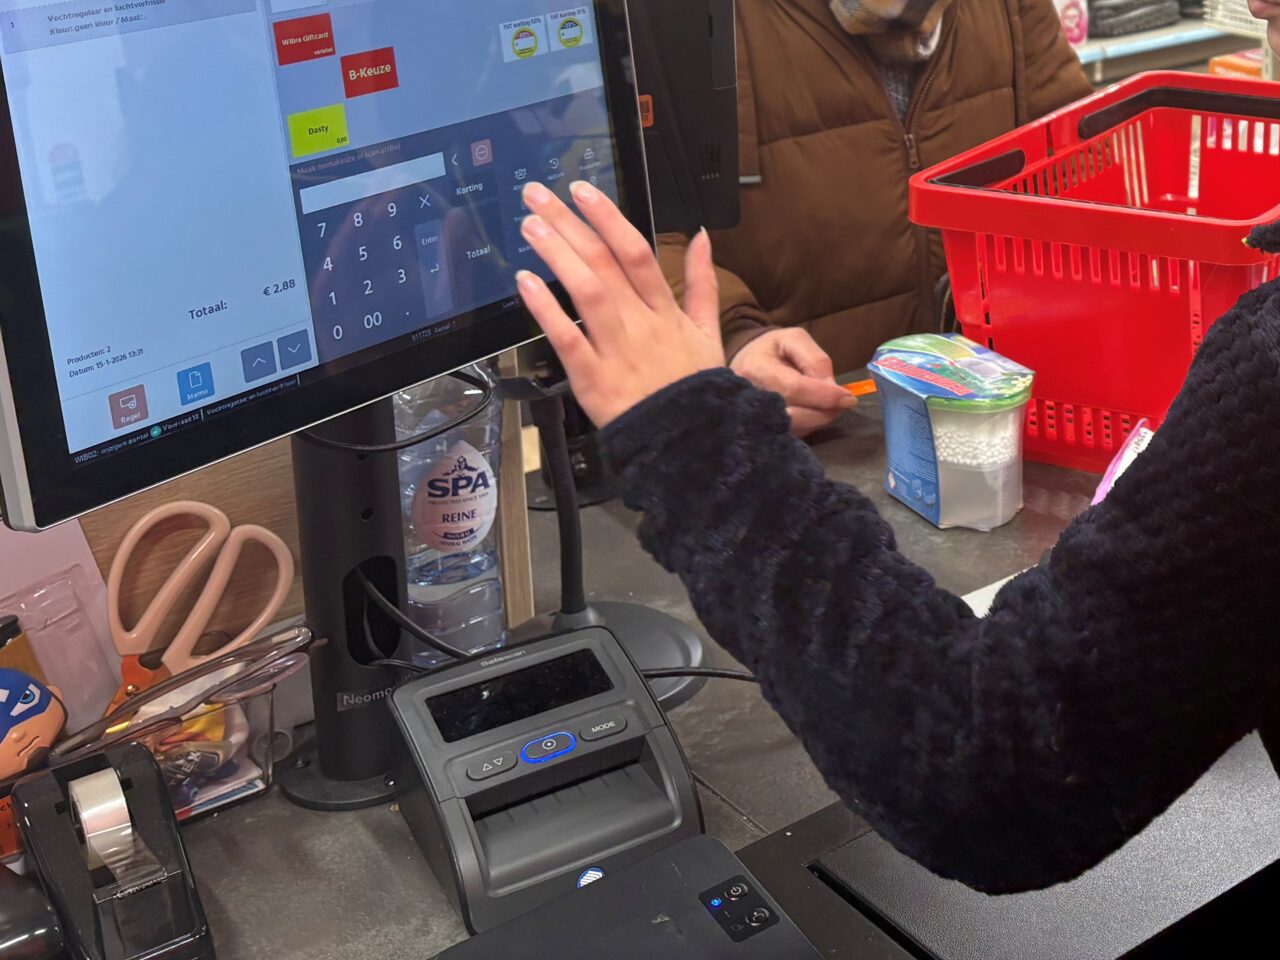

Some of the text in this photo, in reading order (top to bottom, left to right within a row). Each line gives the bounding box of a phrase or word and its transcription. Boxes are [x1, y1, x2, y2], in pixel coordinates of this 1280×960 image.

[47, 7, 102, 22] Vochtregelaar
[49, 19, 114, 36] Kleur: geen kleur
[281, 32, 329, 46] Wibra Giftcard
[349, 63, 392, 80] B-Keuze
[308, 124, 329, 136] Dasty
[336, 136, 348, 144] 0,00
[456, 181, 483, 196] Korting
[387, 202, 397, 217] 9
[353, 212, 364, 227] 8
[317, 222, 327, 238] 7
[393, 235, 402, 250] 6
[421, 233, 439, 246] Enter
[358, 246, 368, 261] 5
[466, 245, 491, 260] Totaal
[323, 256, 334, 271] 4
[397, 269, 407, 284] 3
[363, 280, 373, 295] 2
[188, 278, 296, 320] Totaal: € 2,88
[329, 292, 337, 305] 1
[364, 311, 382, 329] 00
[333, 324, 343, 340] 0
[67, 349, 105, 365] Producten:
[69, 365, 95, 378] Datum:
[95, 353, 128, 369] 15-1-2026
[187, 388, 209, 401] Memo
[120, 412, 141, 424] Regel
[427, 470, 490, 498] SPA
[442, 508, 477, 523] REINE
[342, 687, 396, 706] Neomo
[591, 720, 616, 733] MODE
